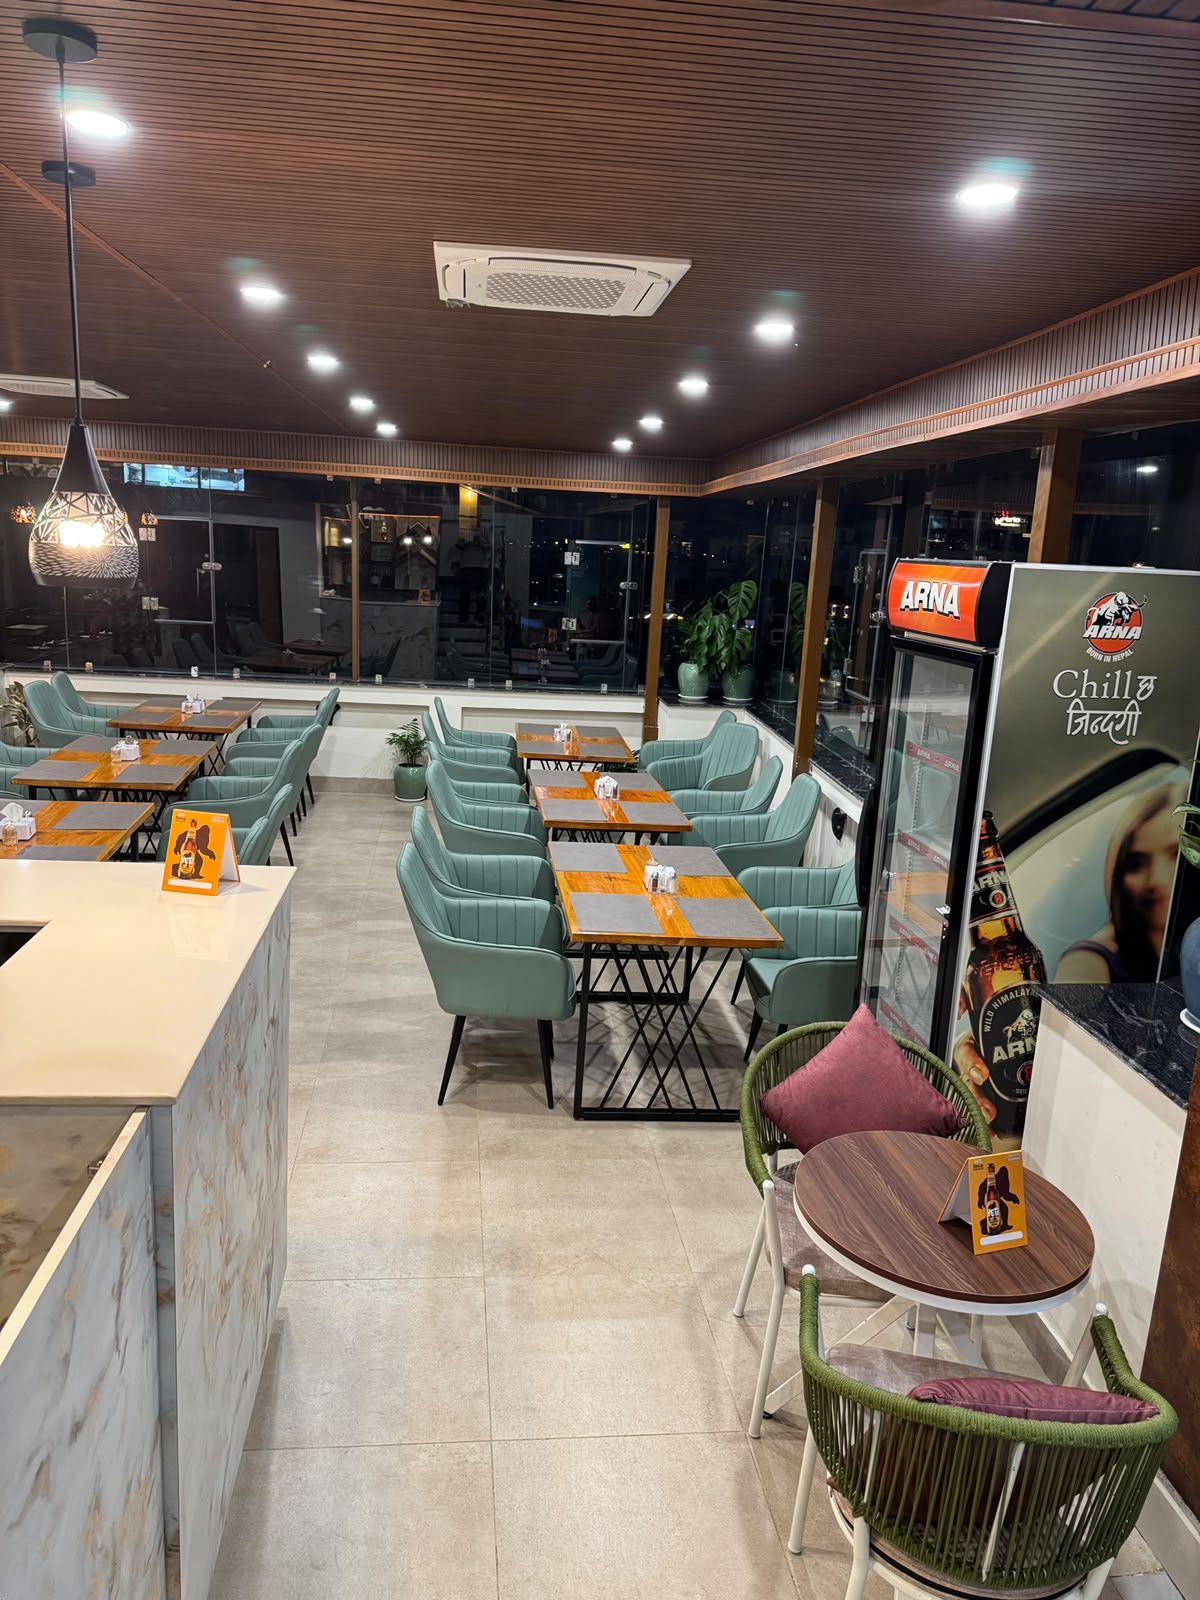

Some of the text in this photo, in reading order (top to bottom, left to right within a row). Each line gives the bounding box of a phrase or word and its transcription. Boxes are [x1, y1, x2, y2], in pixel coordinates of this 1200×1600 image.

[899, 579, 960, 620] ARNA
[1082, 624, 1142, 640] ARNA
[1086, 647, 1103, 661] BORN
[1112, 649, 1134, 662] NEPAL
[1053, 668, 1132, 699] Chill
[984, 987, 1038, 1032] WILD HIMALAYA
